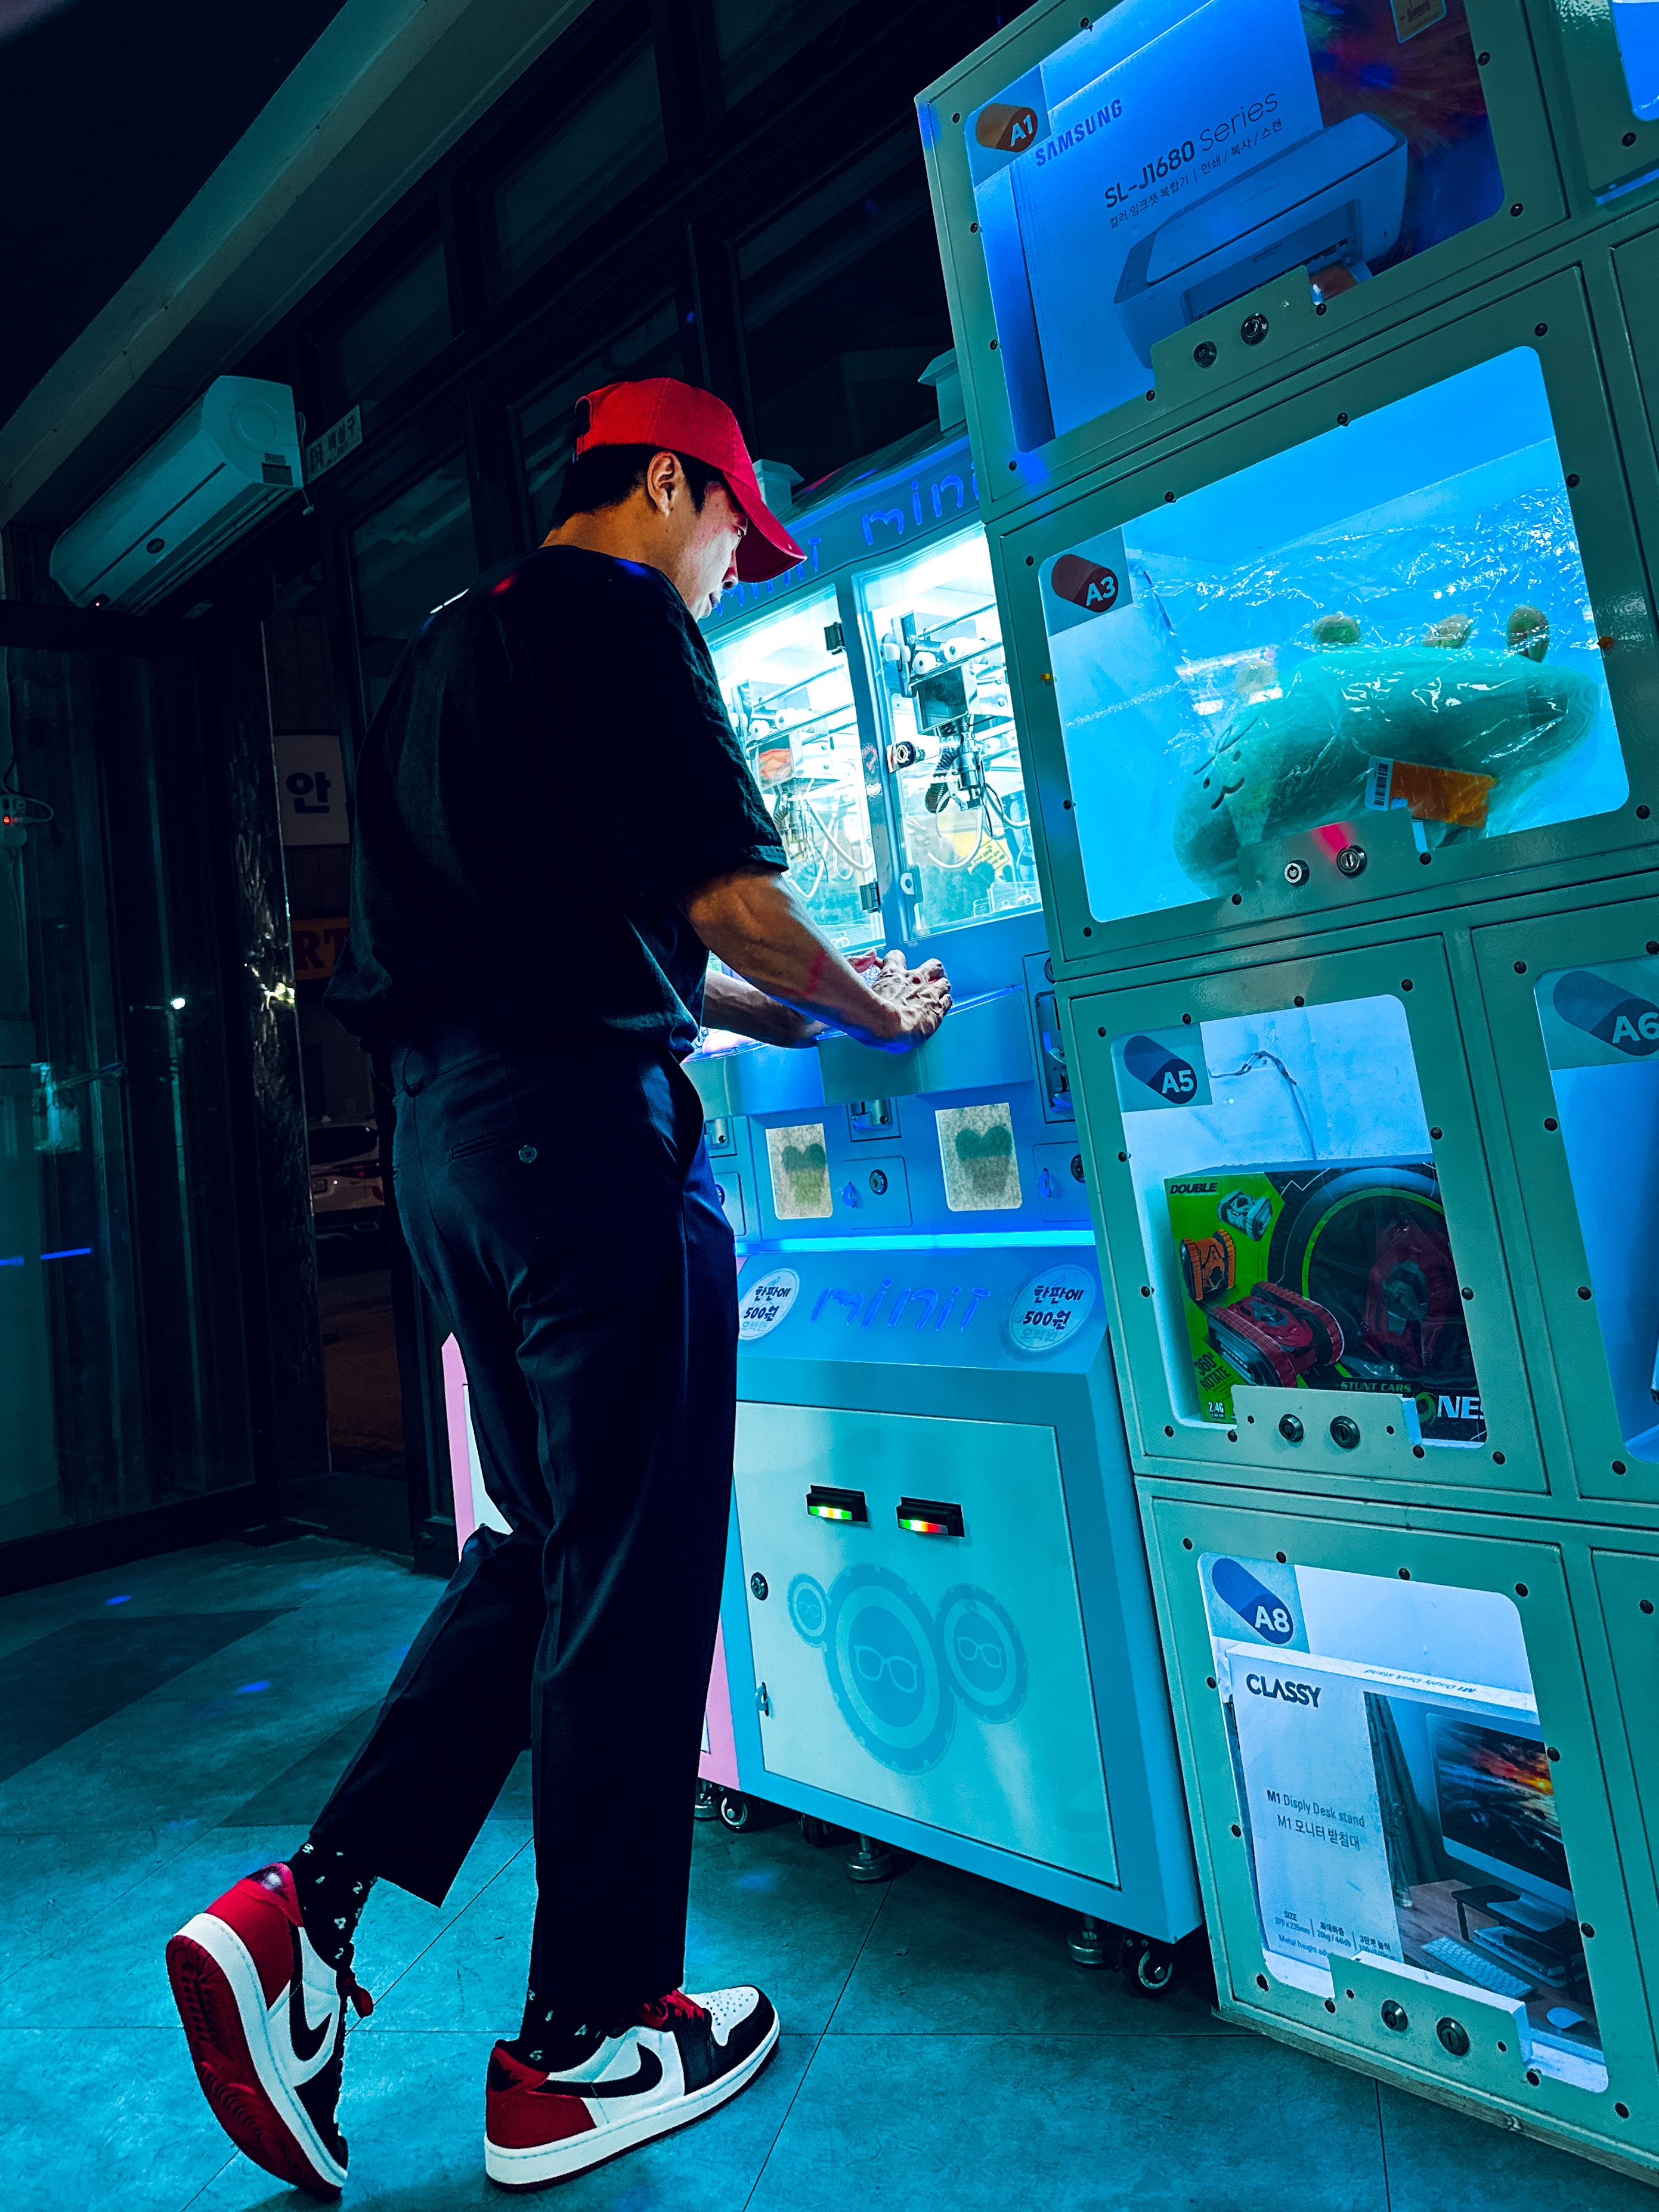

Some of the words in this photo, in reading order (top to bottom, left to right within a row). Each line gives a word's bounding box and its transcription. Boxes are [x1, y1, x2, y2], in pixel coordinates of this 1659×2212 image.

[1010, 114, 1033, 148] A1
[1035, 98, 1123, 168] SAMSUNG
[1104, 140, 1196, 208] SL-J1680
[1200, 93, 1279, 151] Series
[1109, 210, 1128, 229] 컬러
[1129, 191, 1159, 217] 잉크젯
[1160, 174, 1190, 198] 복합기
[1200, 154, 1221, 175] 인쇄
[1230, 137, 1252, 156] 복사
[1261, 118, 1282, 140] 스캔
[1085, 576, 1116, 607] A3
[286, 771, 332, 814] 안
[1612, 1012, 1659, 1043] A6
[1162, 1069, 1194, 1094] A5
[1169, 1182, 1218, 1194] DOUBLE
[754, 1286, 791, 1302] 한판에
[1033, 1285, 1084, 1305] 한판에
[744, 1305, 780, 1321] 500원
[1023, 1310, 1072, 1330] 500원
[1199, 1365, 1231, 1392] ROTATE
[1341, 1381, 1378, 1391] STUNT
[1381, 1383, 1412, 1393] CARS
[1255, 1606, 1290, 1632] A8
[1246, 1673, 1321, 1708] CLASSY
[1396, 1675, 1422, 1683] Desk
[1267, 1790, 1281, 1804] M1
[1283, 1794, 1311, 1814] Disply
[1313, 1802, 1337, 1819] Desk
[1338, 1811, 1365, 1827] stand
[1277, 1814, 1292, 1830] M1
[1295, 1819, 1326, 1841] 모니터
[1328, 1828, 1360, 1851] 받침대
[1283, 1910, 1298, 1921] SIZE
